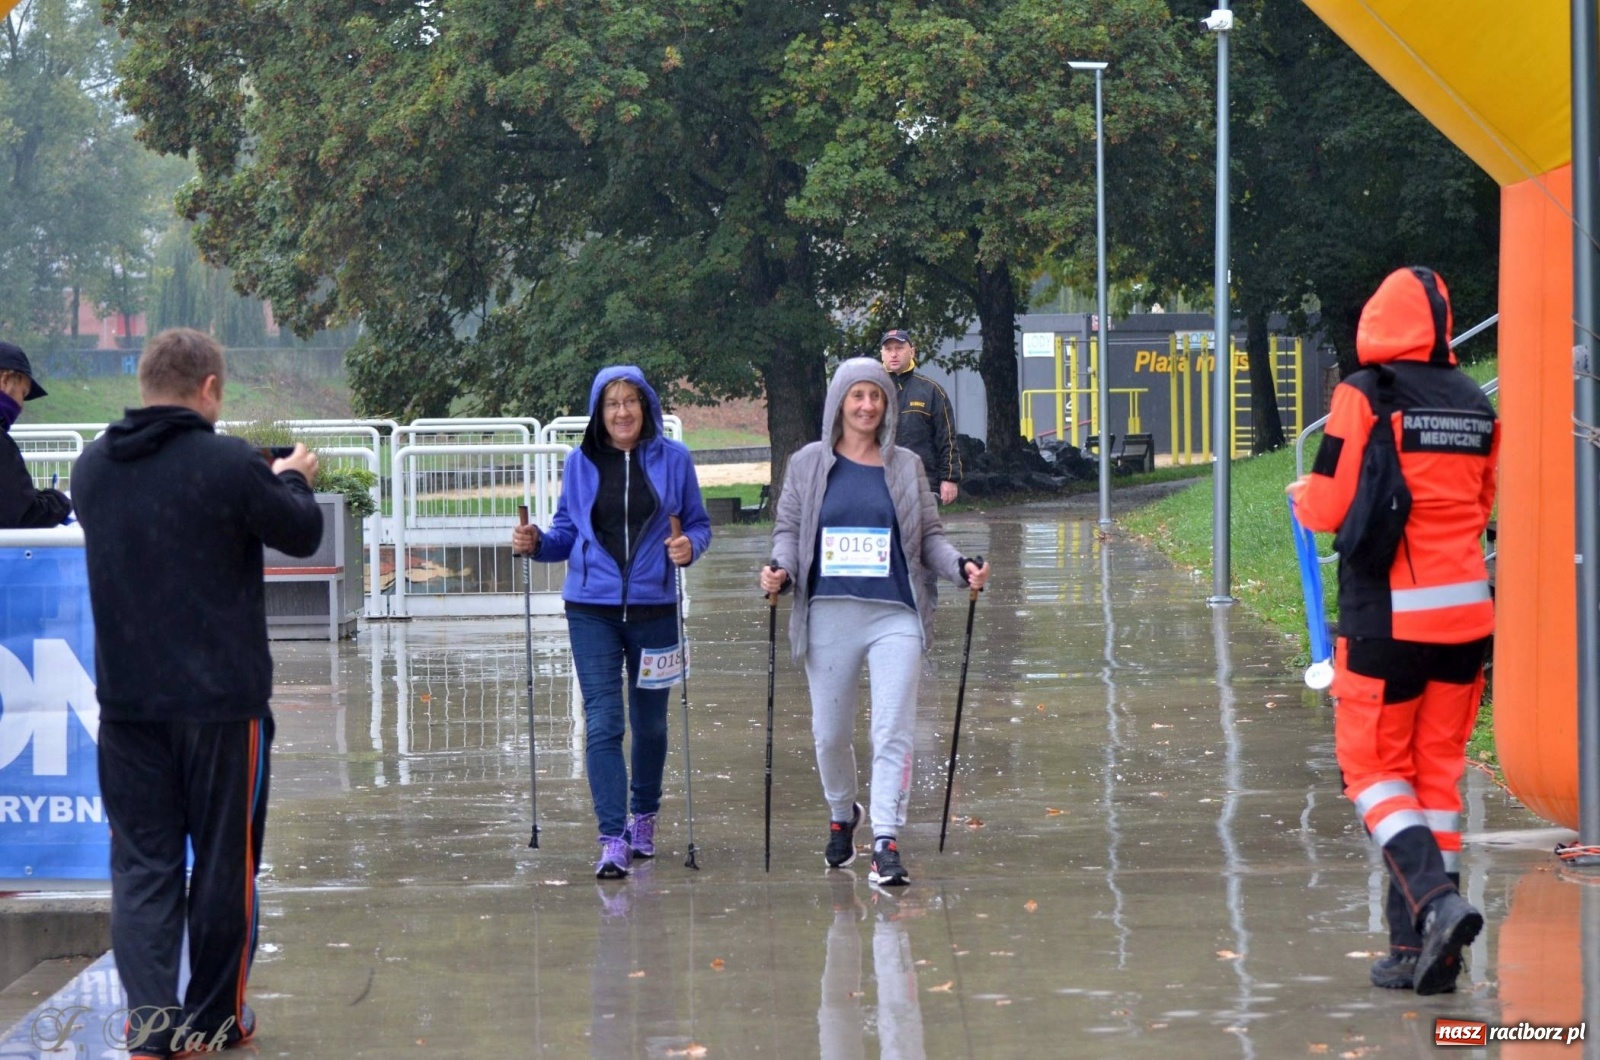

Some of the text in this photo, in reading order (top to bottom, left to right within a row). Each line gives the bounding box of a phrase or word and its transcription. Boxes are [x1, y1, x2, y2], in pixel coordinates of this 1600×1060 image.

[1403, 415, 1493, 433] RATOWNICTWO
[1420, 431, 1482, 448] MEDYCZNE
[839, 536, 873, 553] 016
[0, 795, 109, 823] RYBN
